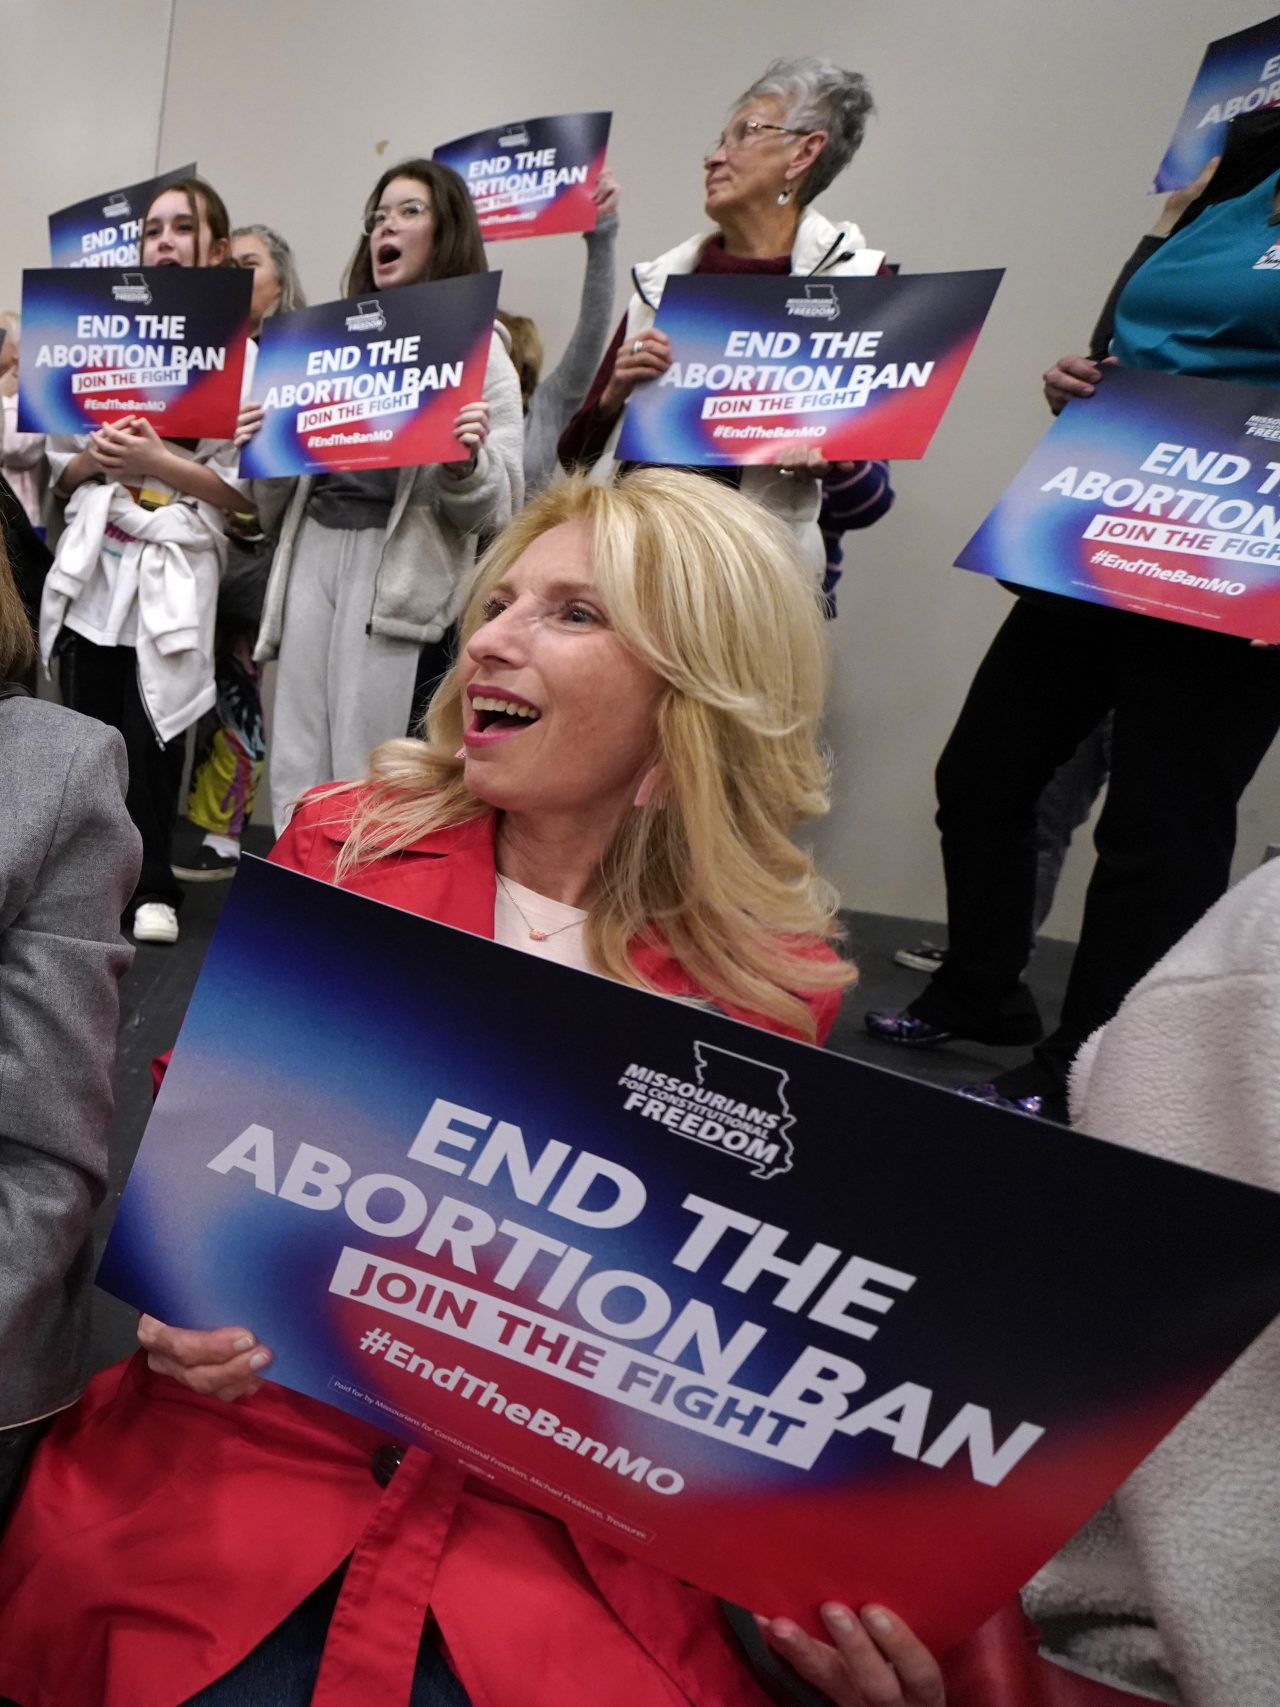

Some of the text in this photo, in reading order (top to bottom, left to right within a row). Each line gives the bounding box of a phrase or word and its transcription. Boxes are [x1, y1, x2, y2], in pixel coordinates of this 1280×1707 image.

[469, 148, 557, 178] END THE
[467, 165, 589, 198] ORTION BAN
[81, 217, 144, 253] END TH
[77, 315, 186, 340] END THE
[725, 331, 883, 359] END THE
[35, 345, 226, 371] ABORTION BAN
[306, 335, 421, 376] END THE
[77, 369, 181, 391] JOIN THE FIGHT
[262, 361, 464, 411] ABORTION BAN
[660, 361, 935, 392] ABORTION BAN
[84, 398, 166, 412] #EndTheBanMO
[302, 394, 412, 429] JOIN THE FIGHT
[709, 391, 861, 416] JOIN THE FIGHT
[307, 430, 393, 449] #EndTheBanMO
[713, 424, 827, 440] #EndTheBanMO
[1140, 441, 1252, 486] END
[1094, 520, 1157, 542] JOIN
[1164, 529, 1217, 552] THE
[1090, 549, 1247, 597] #EndTheBanMO
[617, 1076, 770, 1140] FOR CONSTITUTIONAL
[623, 1063, 782, 1129] MISSOURIANS
[623, 1091, 781, 1164] FREEDOM
[407, 1097, 918, 1342] END THE
[206, 1122, 1046, 1488] ABORTION BAN
[350, 1263, 807, 1448] JOIN THE FIGHT
[358, 1327, 685, 1496] #EndTheBanMO
